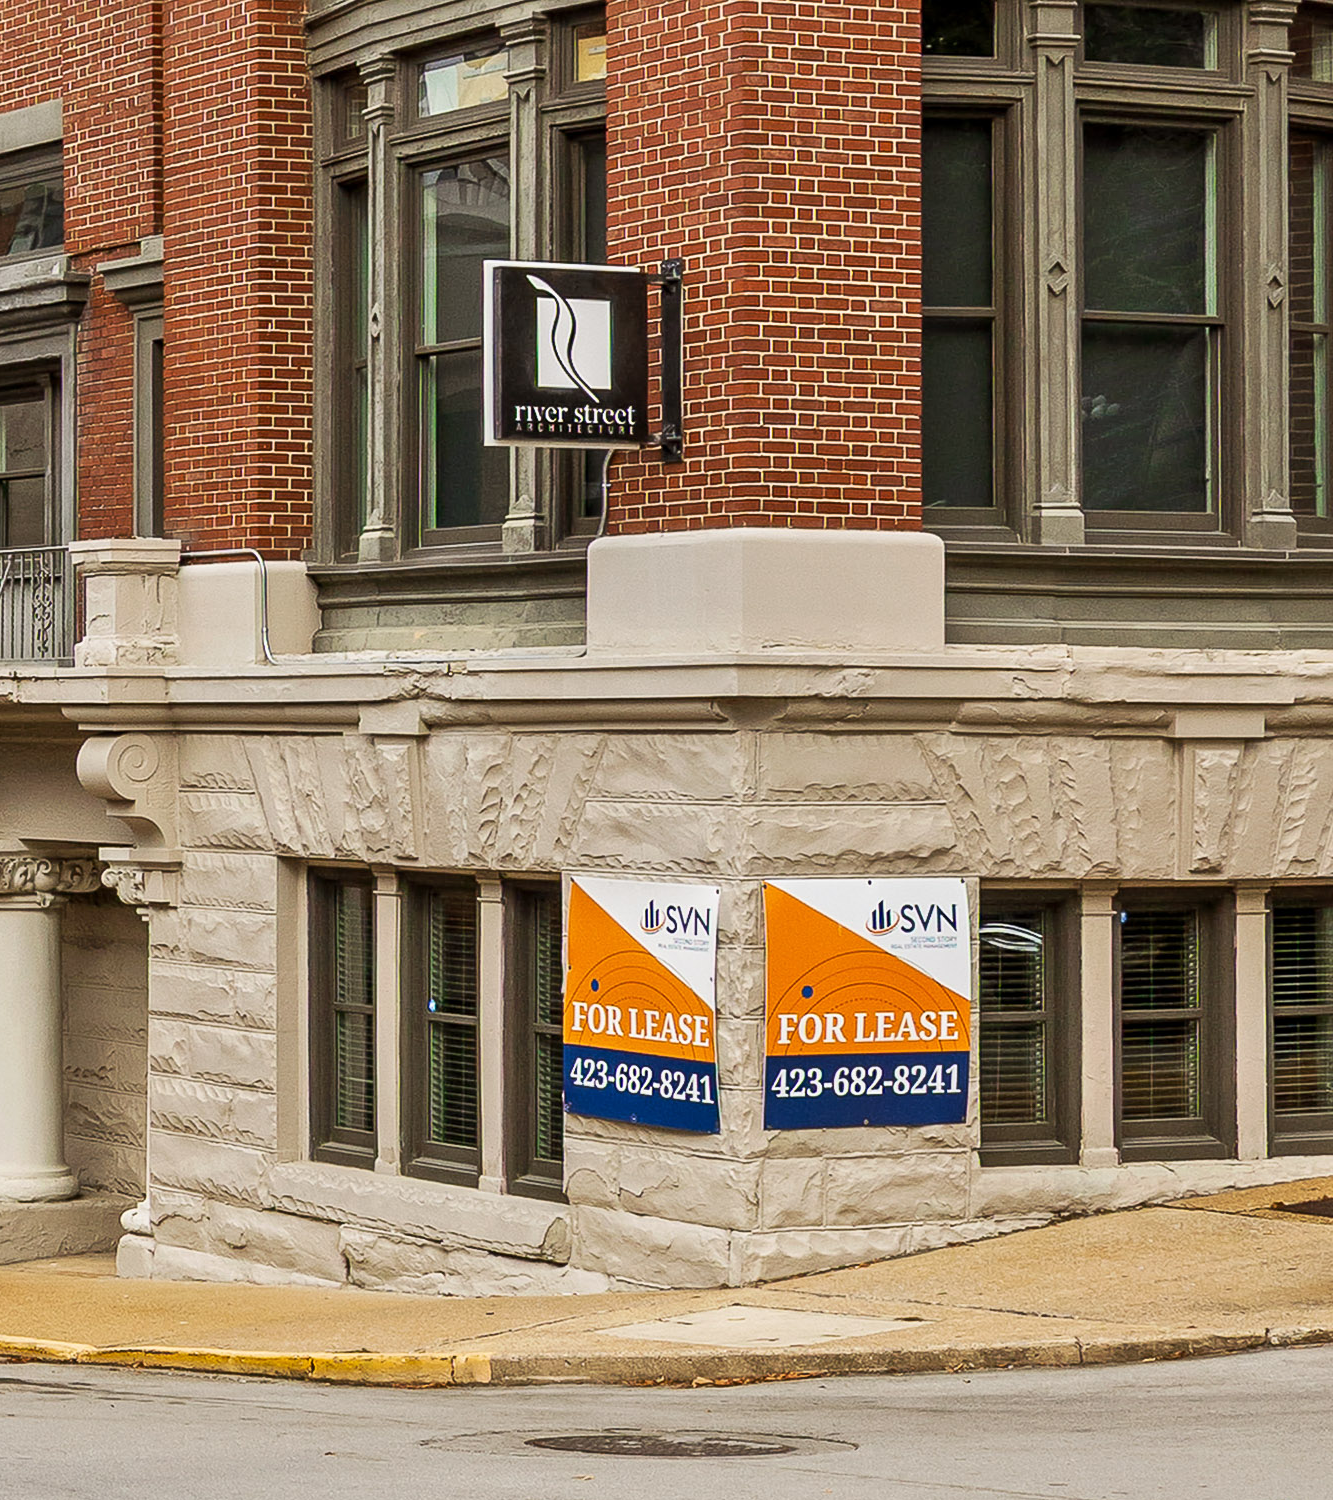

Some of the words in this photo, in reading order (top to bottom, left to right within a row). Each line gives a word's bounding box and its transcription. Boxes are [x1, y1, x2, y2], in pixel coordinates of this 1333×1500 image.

[514, 405, 569, 423] river
[574, 404, 636, 425] street
[516, 423, 634, 435] ARCHITECTURE
[666, 904, 710, 936] SVN
[900, 903, 957, 933] SVN
[571, 1001, 624, 1037] FOR
[628, 1008, 709, 1047] LEASE
[777, 1013, 847, 1045] FOR
[854, 1010, 959, 1043] LEASE
[569, 1057, 715, 1104] 423-682-8241
[771, 1063, 962, 1098] 423-682-8241
